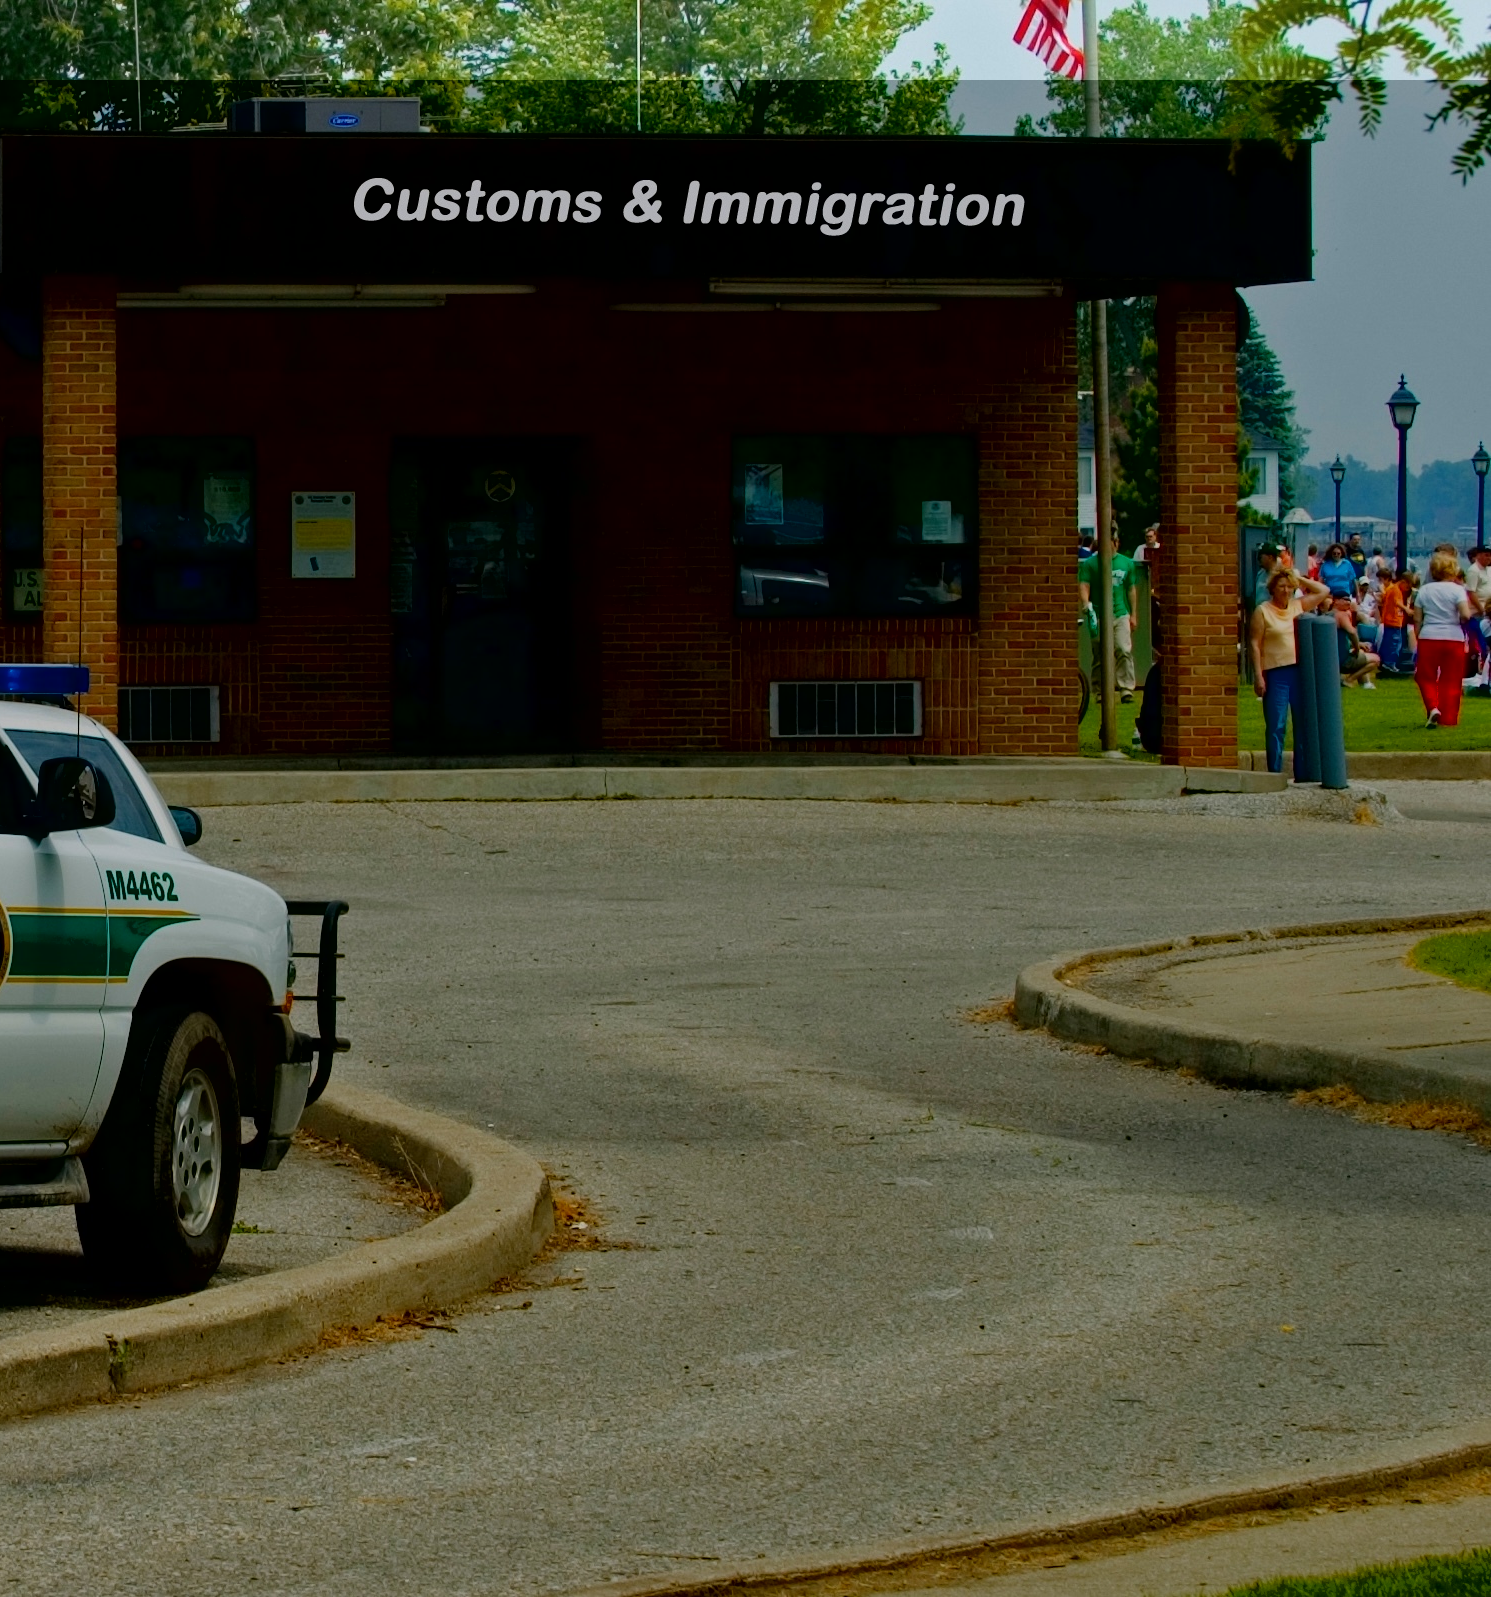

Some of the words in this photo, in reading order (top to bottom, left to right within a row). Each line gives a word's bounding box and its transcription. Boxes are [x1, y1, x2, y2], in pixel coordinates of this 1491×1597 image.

[353, 177, 603, 223] Customs
[623, 179, 663, 224] &
[683, 180, 1026, 237] Immigration
[106, 870, 179, 902] M4462
